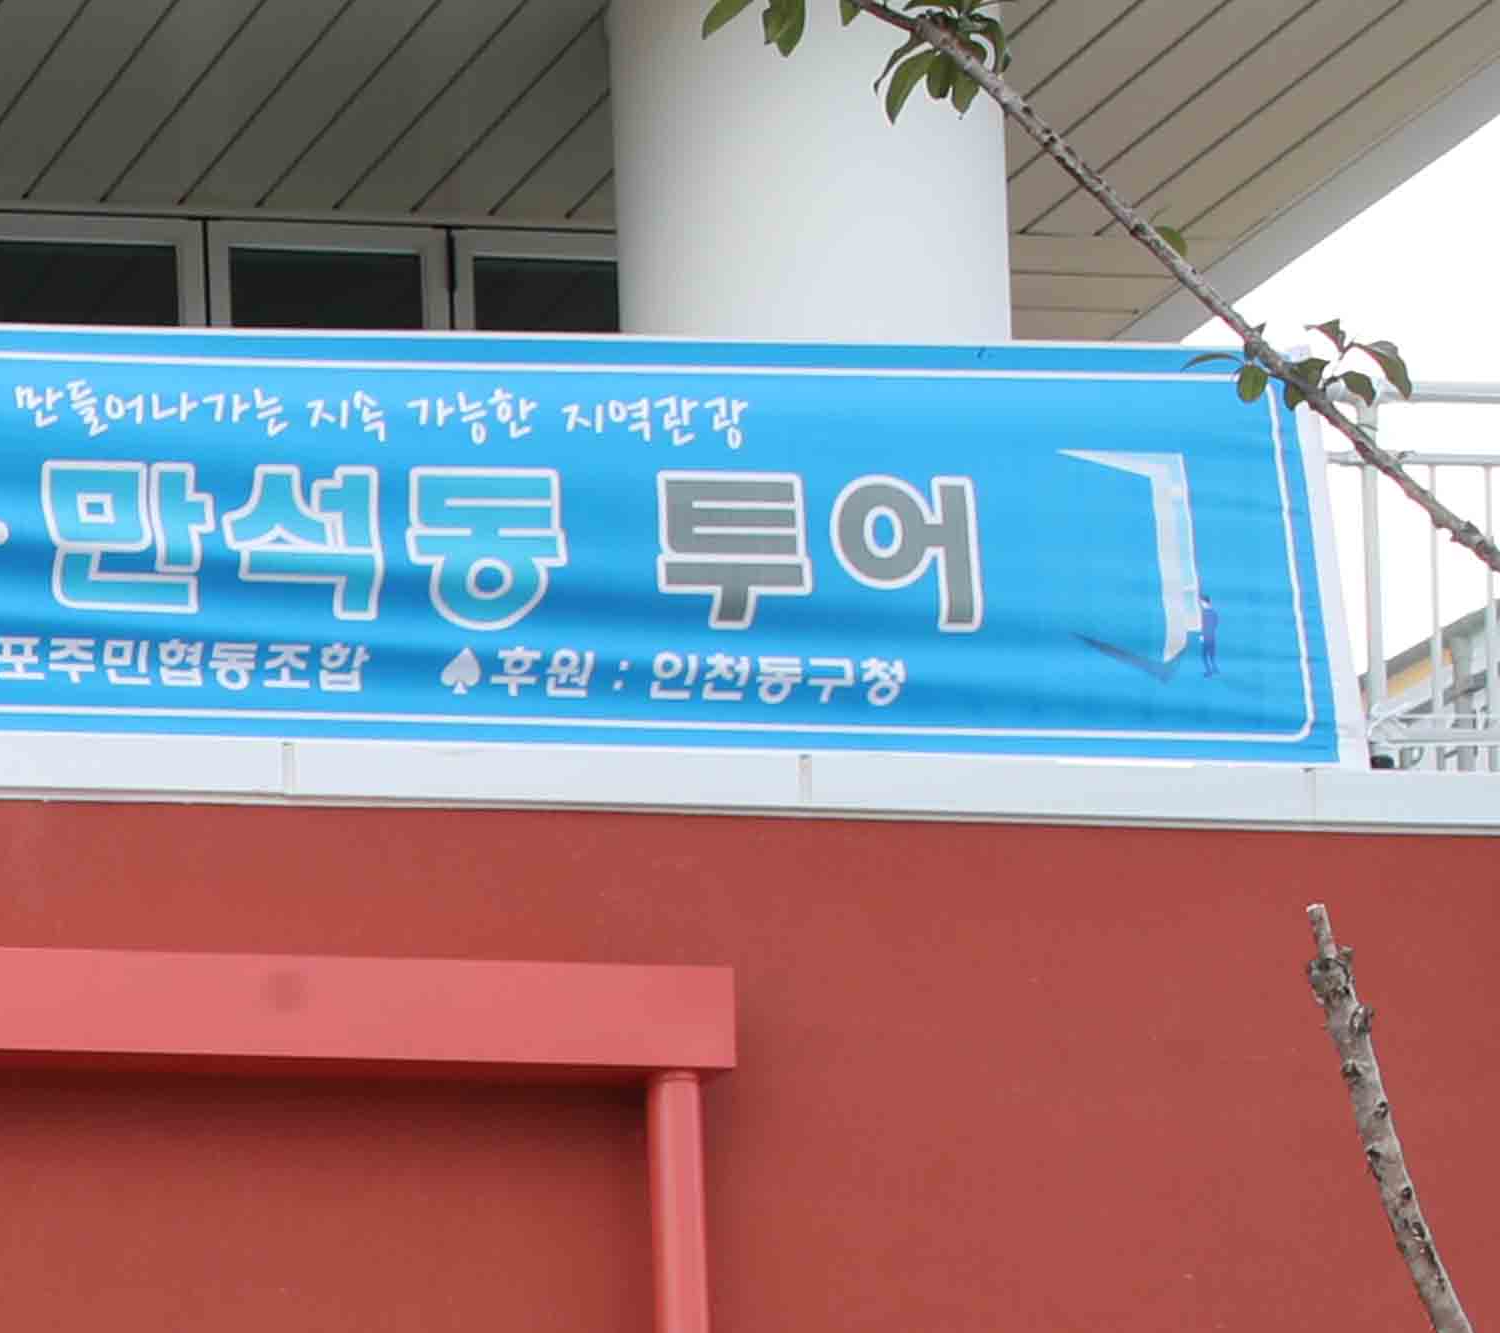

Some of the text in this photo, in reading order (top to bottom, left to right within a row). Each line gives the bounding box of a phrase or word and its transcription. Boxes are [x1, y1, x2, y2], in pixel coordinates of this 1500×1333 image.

[14, 379, 289, 437] 만들어나가는
[306, 390, 388, 442] 지속
[406, 387, 537, 445] 가능한
[561, 395, 749, 449] 지역관광
[655, 470, 983, 634] 투어
[490, 646, 595, 699] 후원
[648, 650, 908, 706] 인천동구청
